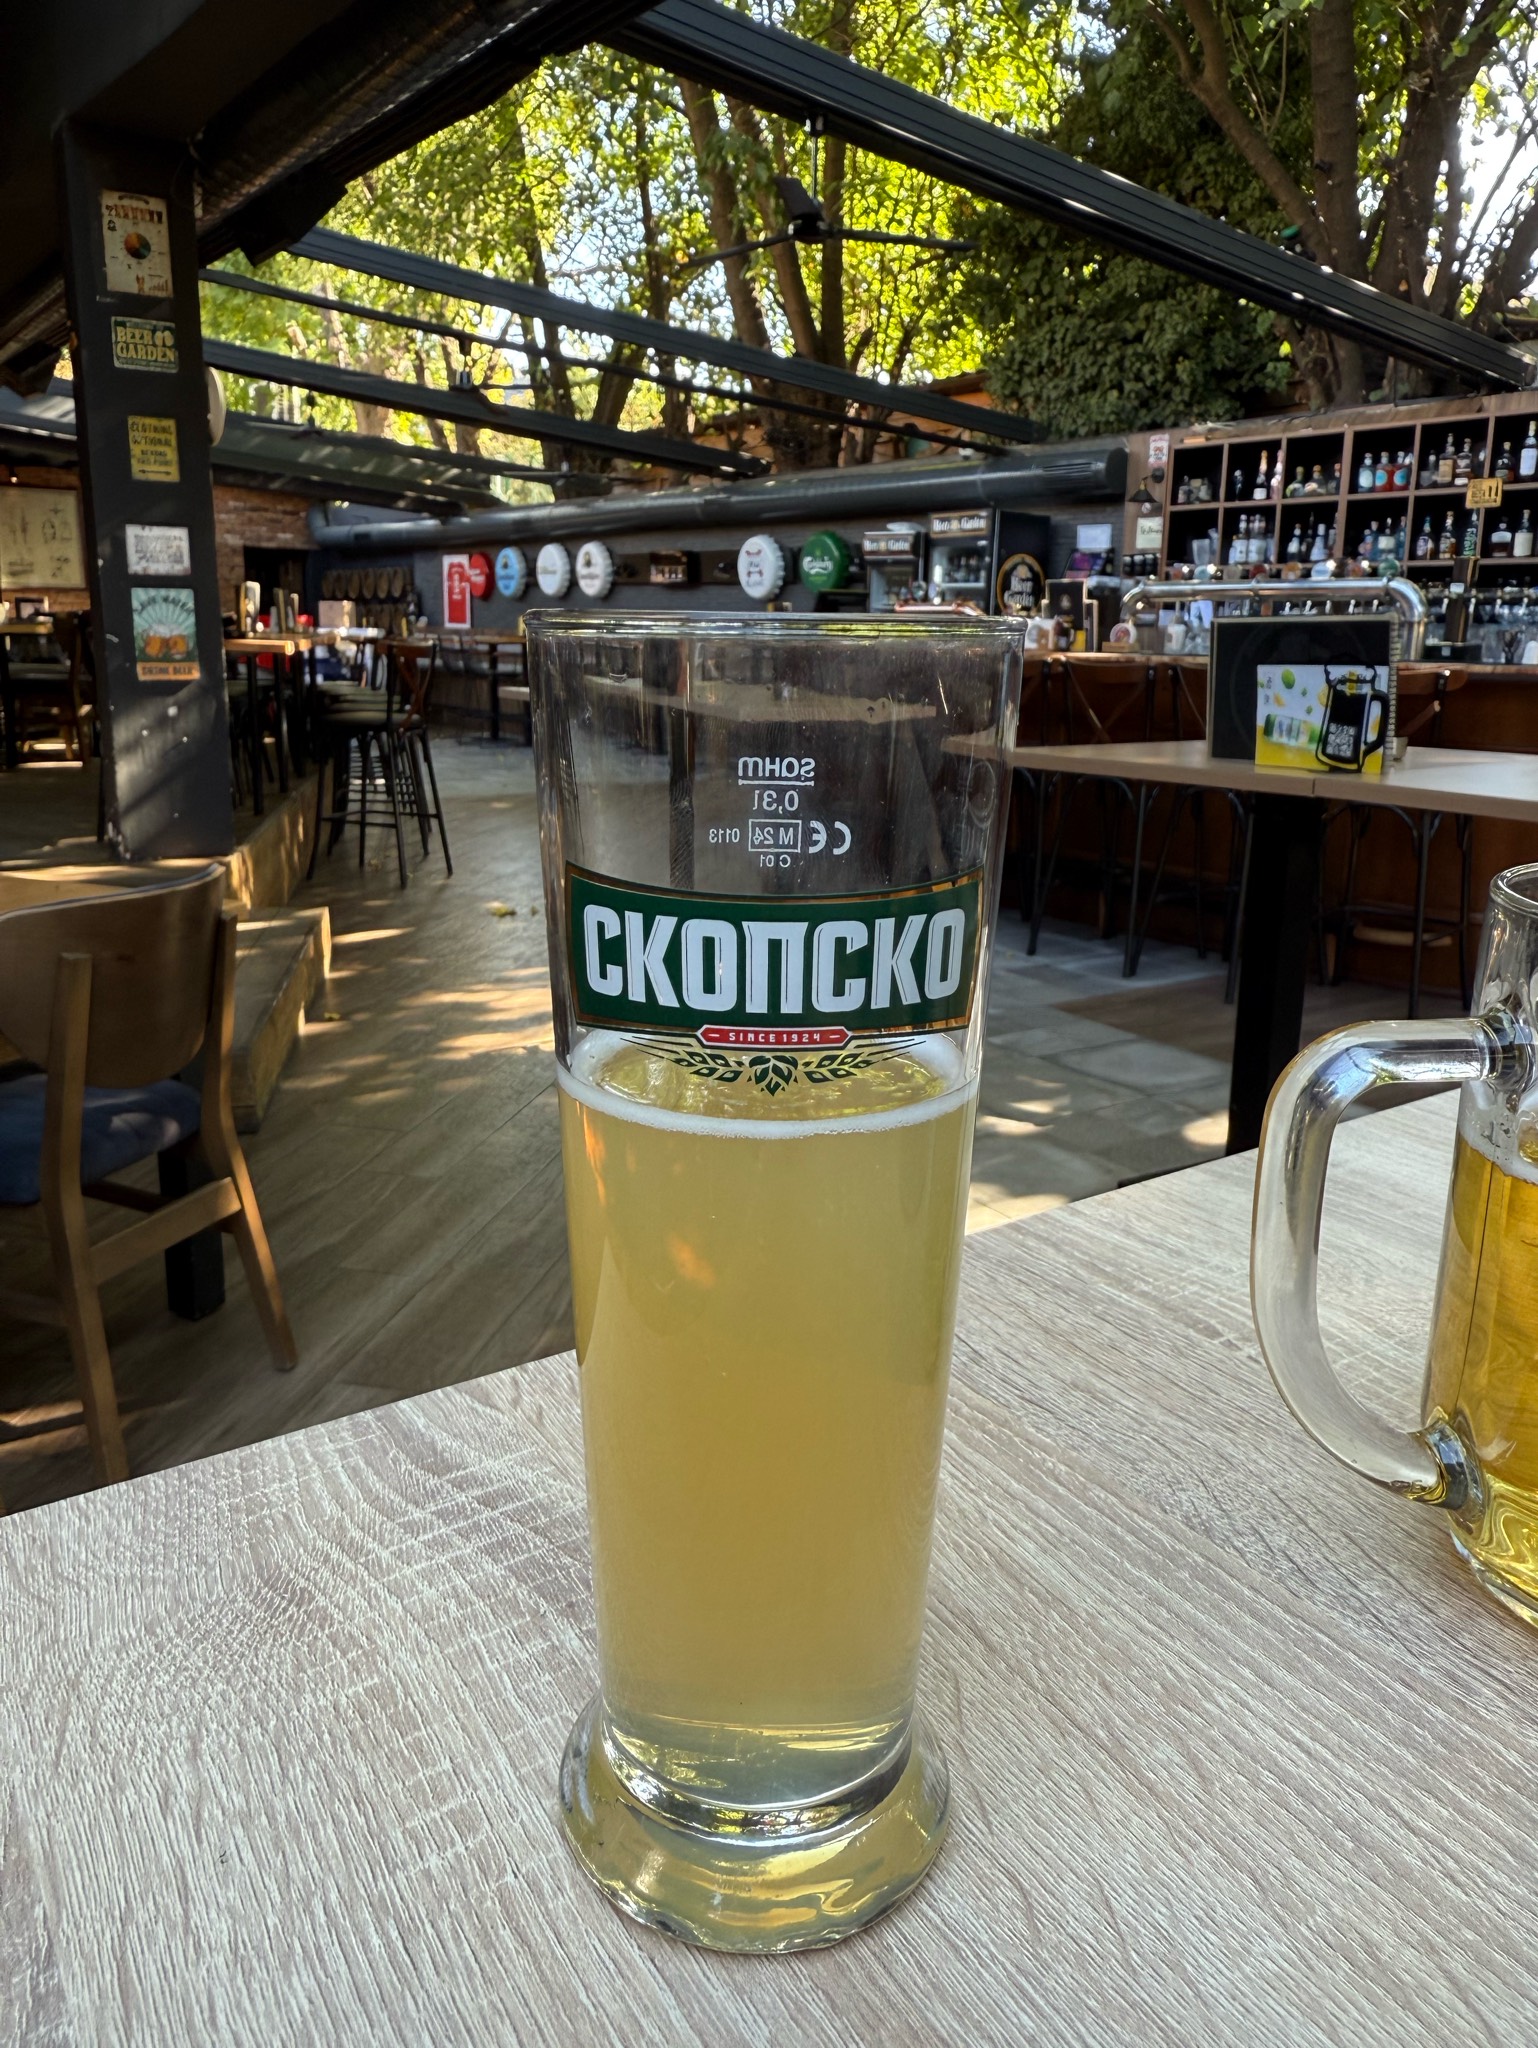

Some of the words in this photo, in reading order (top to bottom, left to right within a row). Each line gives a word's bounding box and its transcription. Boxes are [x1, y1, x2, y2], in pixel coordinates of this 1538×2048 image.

[116, 326, 153, 345] BEER
[116, 342, 175, 363] GARDEN
[582, 903, 967, 1015] СКОПСКО
[728, 1031, 776, 1043] SINCE
[782, 1031, 821, 1043] 1924
